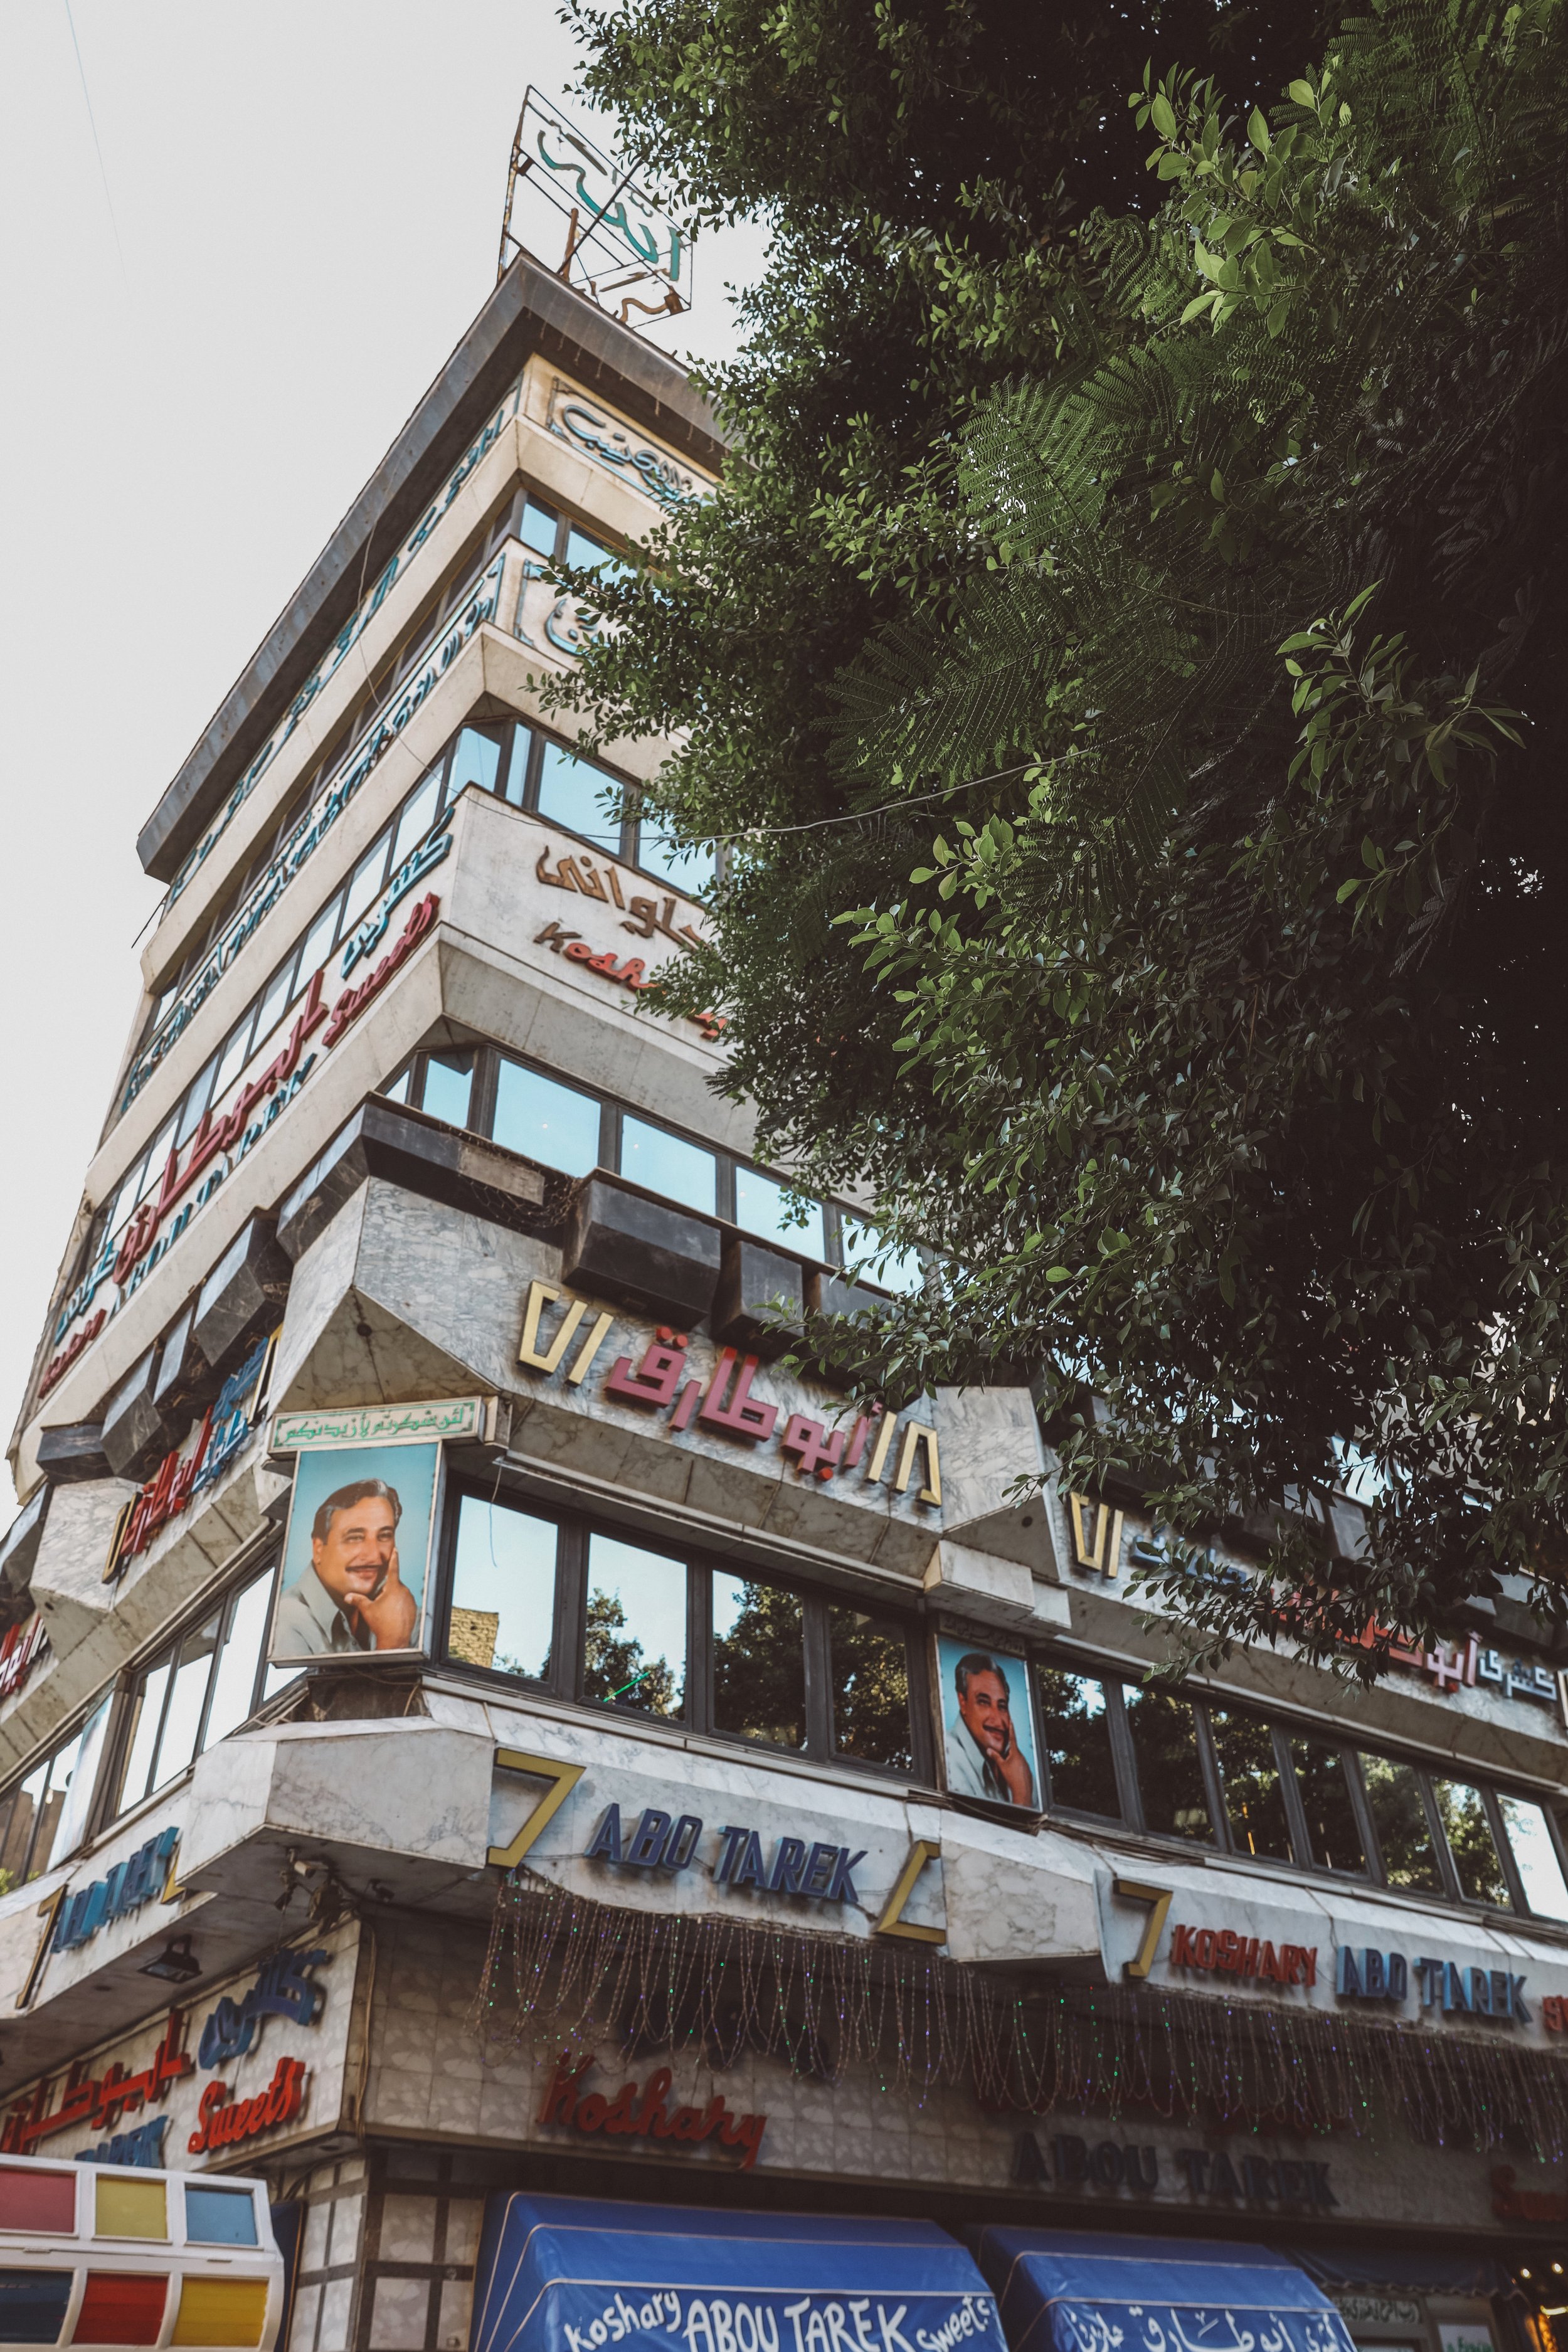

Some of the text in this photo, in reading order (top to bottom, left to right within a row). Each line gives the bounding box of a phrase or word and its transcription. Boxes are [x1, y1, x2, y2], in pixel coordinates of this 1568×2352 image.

[322, 891, 440, 1049] Sweets
[532, 921, 729, 1039] Kosh
[584, 1802, 869, 1904] ABO TAREK
[1171, 1924, 1318, 1987] KOSHARY
[1336, 1946, 1407, 2001] ABO
[1414, 1956, 1533, 2023] TAREK
[188, 2057, 306, 2155] Sweets
[536, 2052, 766, 2170] Koshary
[1013, 2132, 1341, 2208] ABOU TAREK
[682, 2299, 779, 2352] ABOU
[784, 2296, 915, 2352] TAREK
